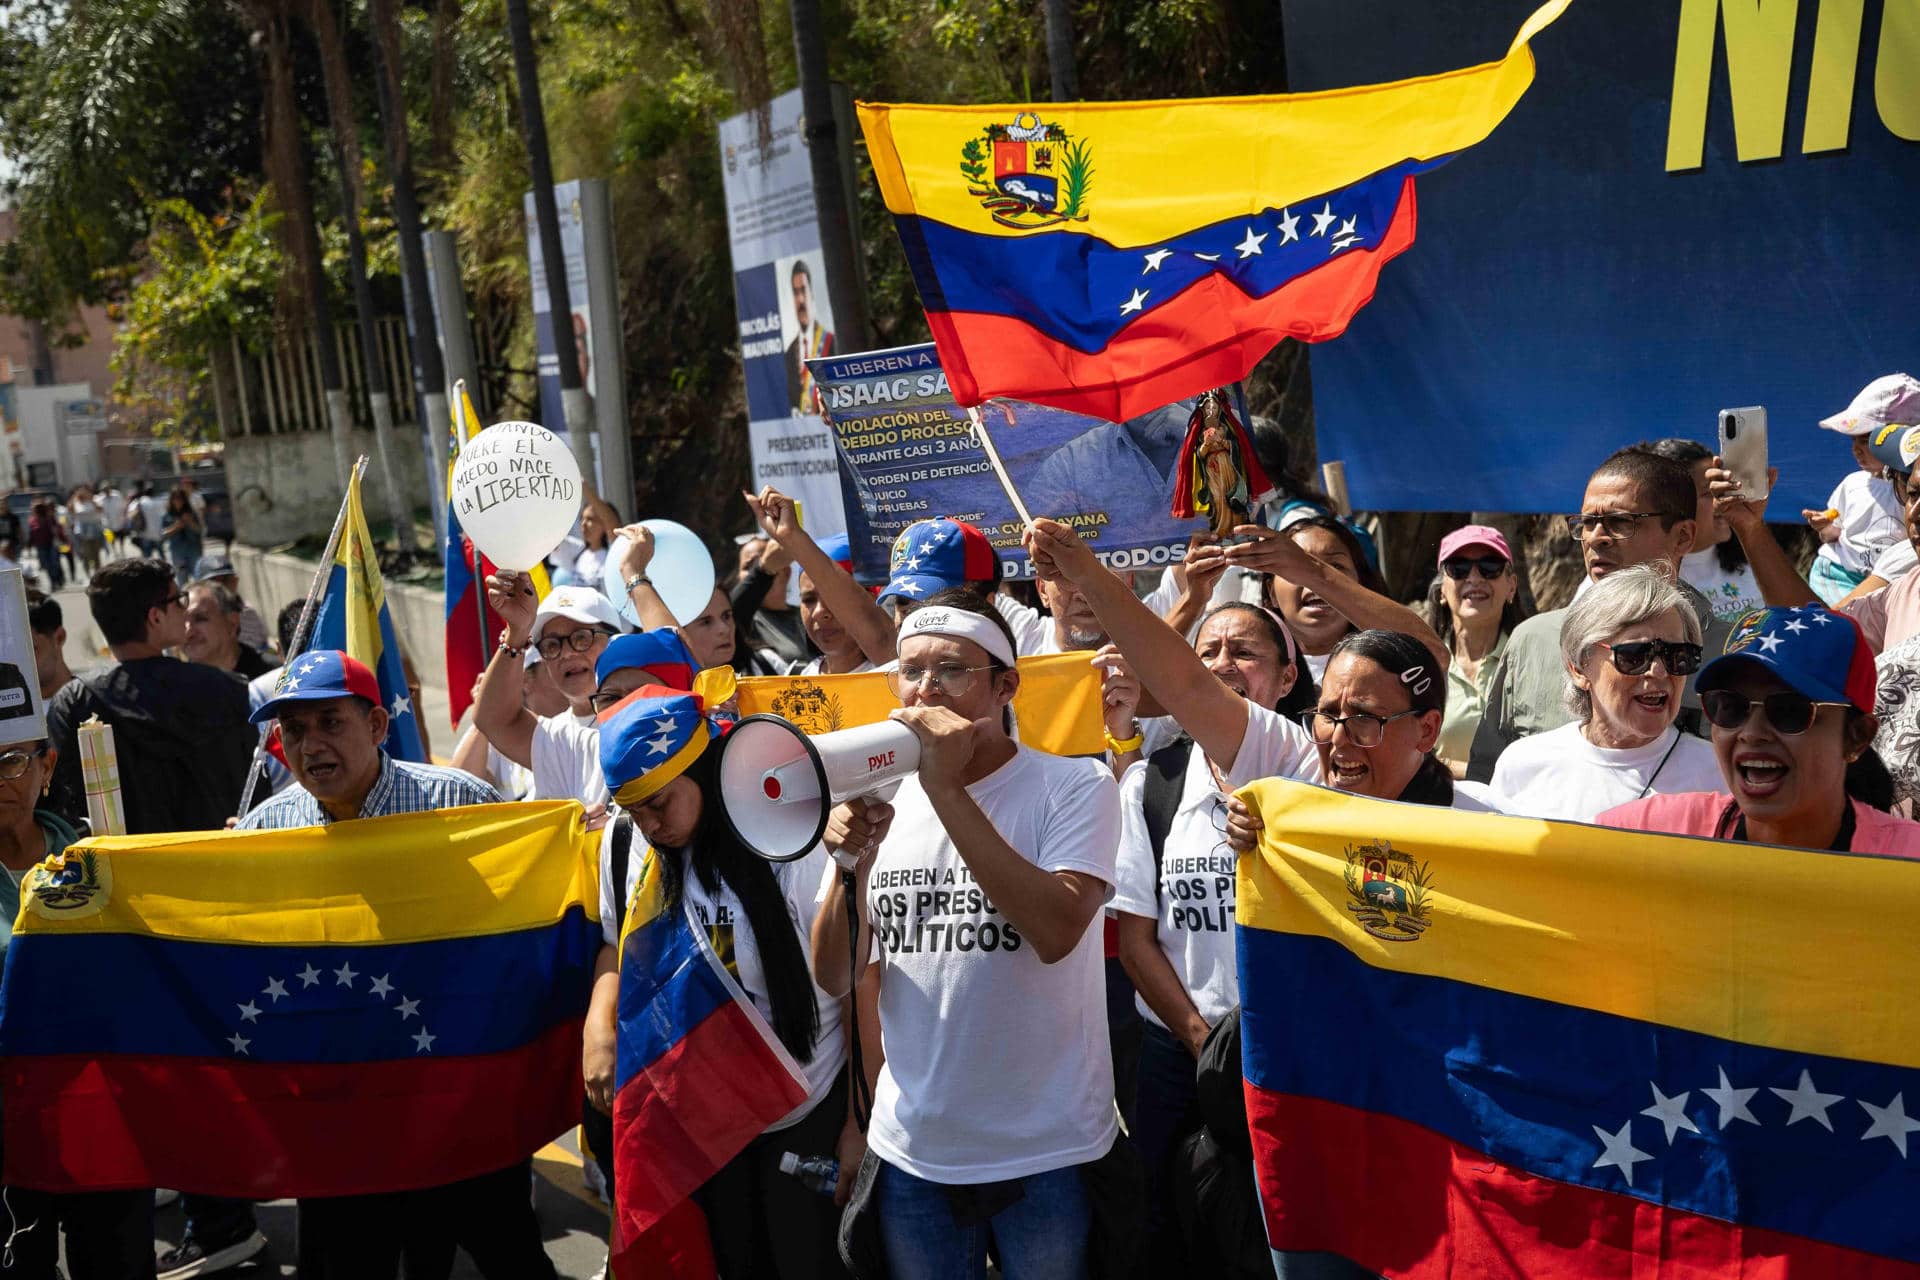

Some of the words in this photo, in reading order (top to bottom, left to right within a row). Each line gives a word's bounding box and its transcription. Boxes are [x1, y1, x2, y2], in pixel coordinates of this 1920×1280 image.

[833, 355, 913, 378] LIBEREN
[918, 353, 933, 365] A
[832, 378, 910, 409] ISAAC
[836, 411, 920, 435] VIOLACIÓN
[924, 410, 950, 423] DEL
[768, 434, 829, 452] PRESIDENTE
[841, 431, 898, 450] DEBIDO
[901, 421, 973, 442] PROCESO
[516, 438, 539, 456] EL
[904, 445, 933, 458] CASI
[935, 440, 946, 453] 3
[949, 437, 985, 452] AÑO
[456, 461, 498, 491] MIEDO
[510, 458, 553, 474] NACE
[869, 472, 909, 486] ORDEN
[912, 471, 928, 481] DE
[460, 498, 474, 515] LA
[475, 475, 574, 513] LIBERTAD
[874, 489, 907, 501] JUICIO
[878, 501, 928, 513] PRUEBAS
[1095, 543, 1187, 569] TODOS
[868, 750, 895, 772] PYLE
[1165, 857, 1233, 875] LIBEREN
[871, 868, 937, 890] LIBEREN
[943, 868, 956, 885] A
